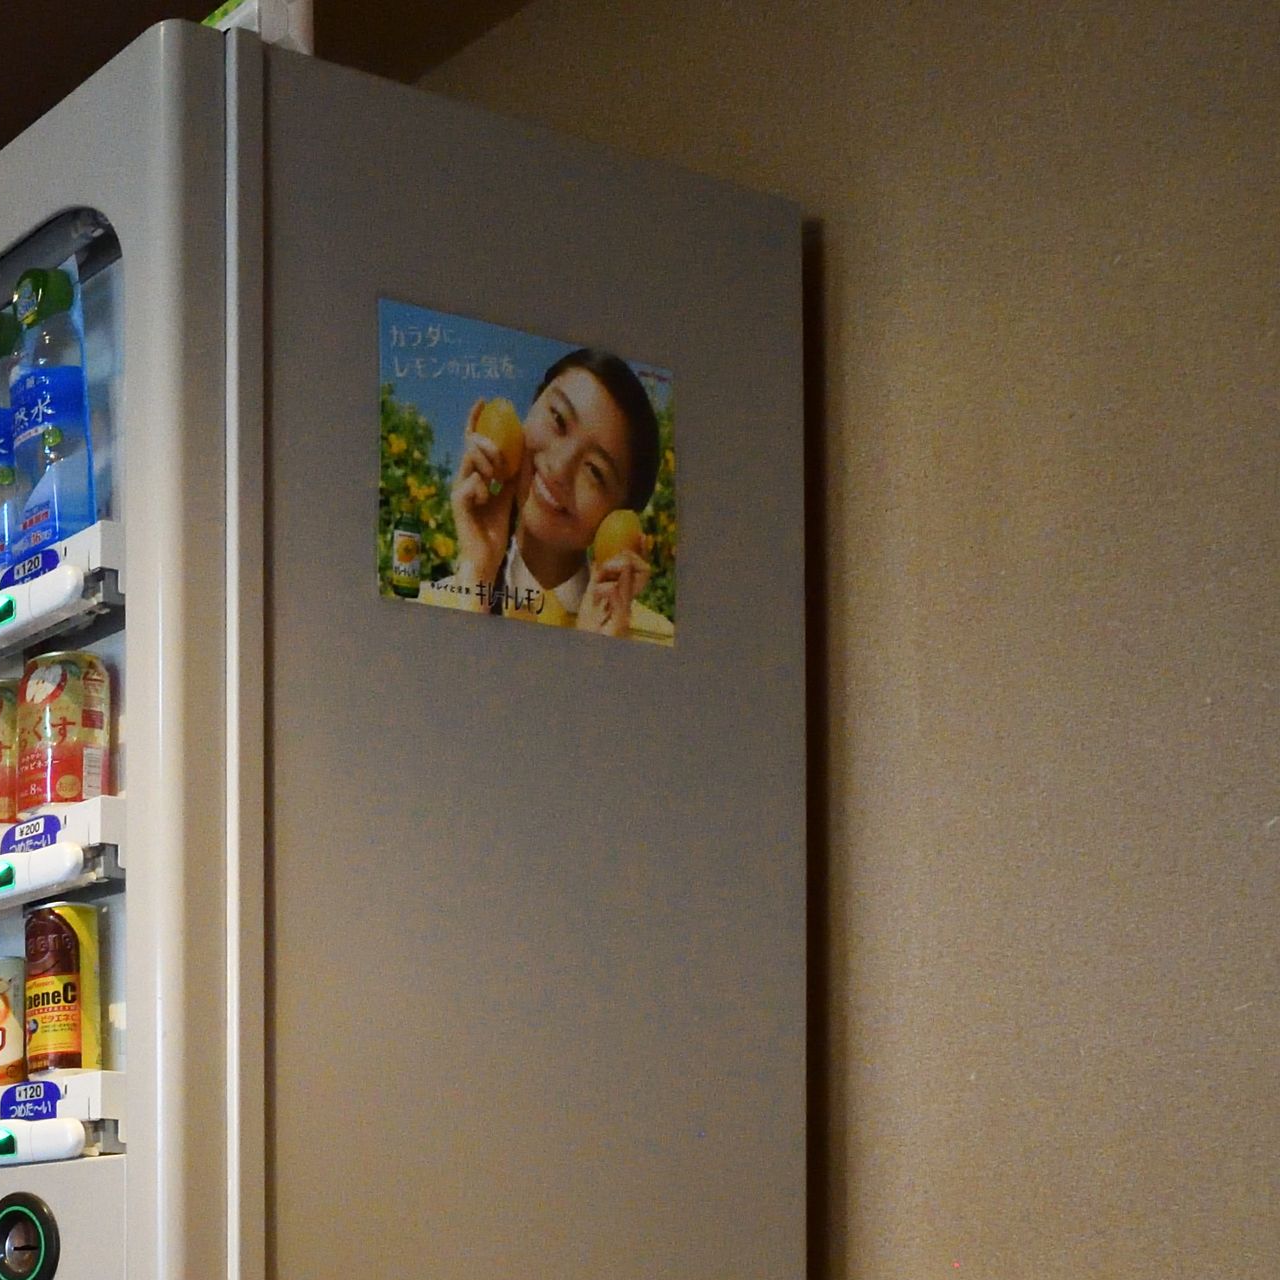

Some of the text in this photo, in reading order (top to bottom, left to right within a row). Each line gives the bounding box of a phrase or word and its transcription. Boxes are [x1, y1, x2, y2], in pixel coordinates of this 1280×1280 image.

[475, 580, 545, 615] キレートレモン
[18, 821, 40, 837] ¥200
[17, 1084, 42, 1099] ¥120
